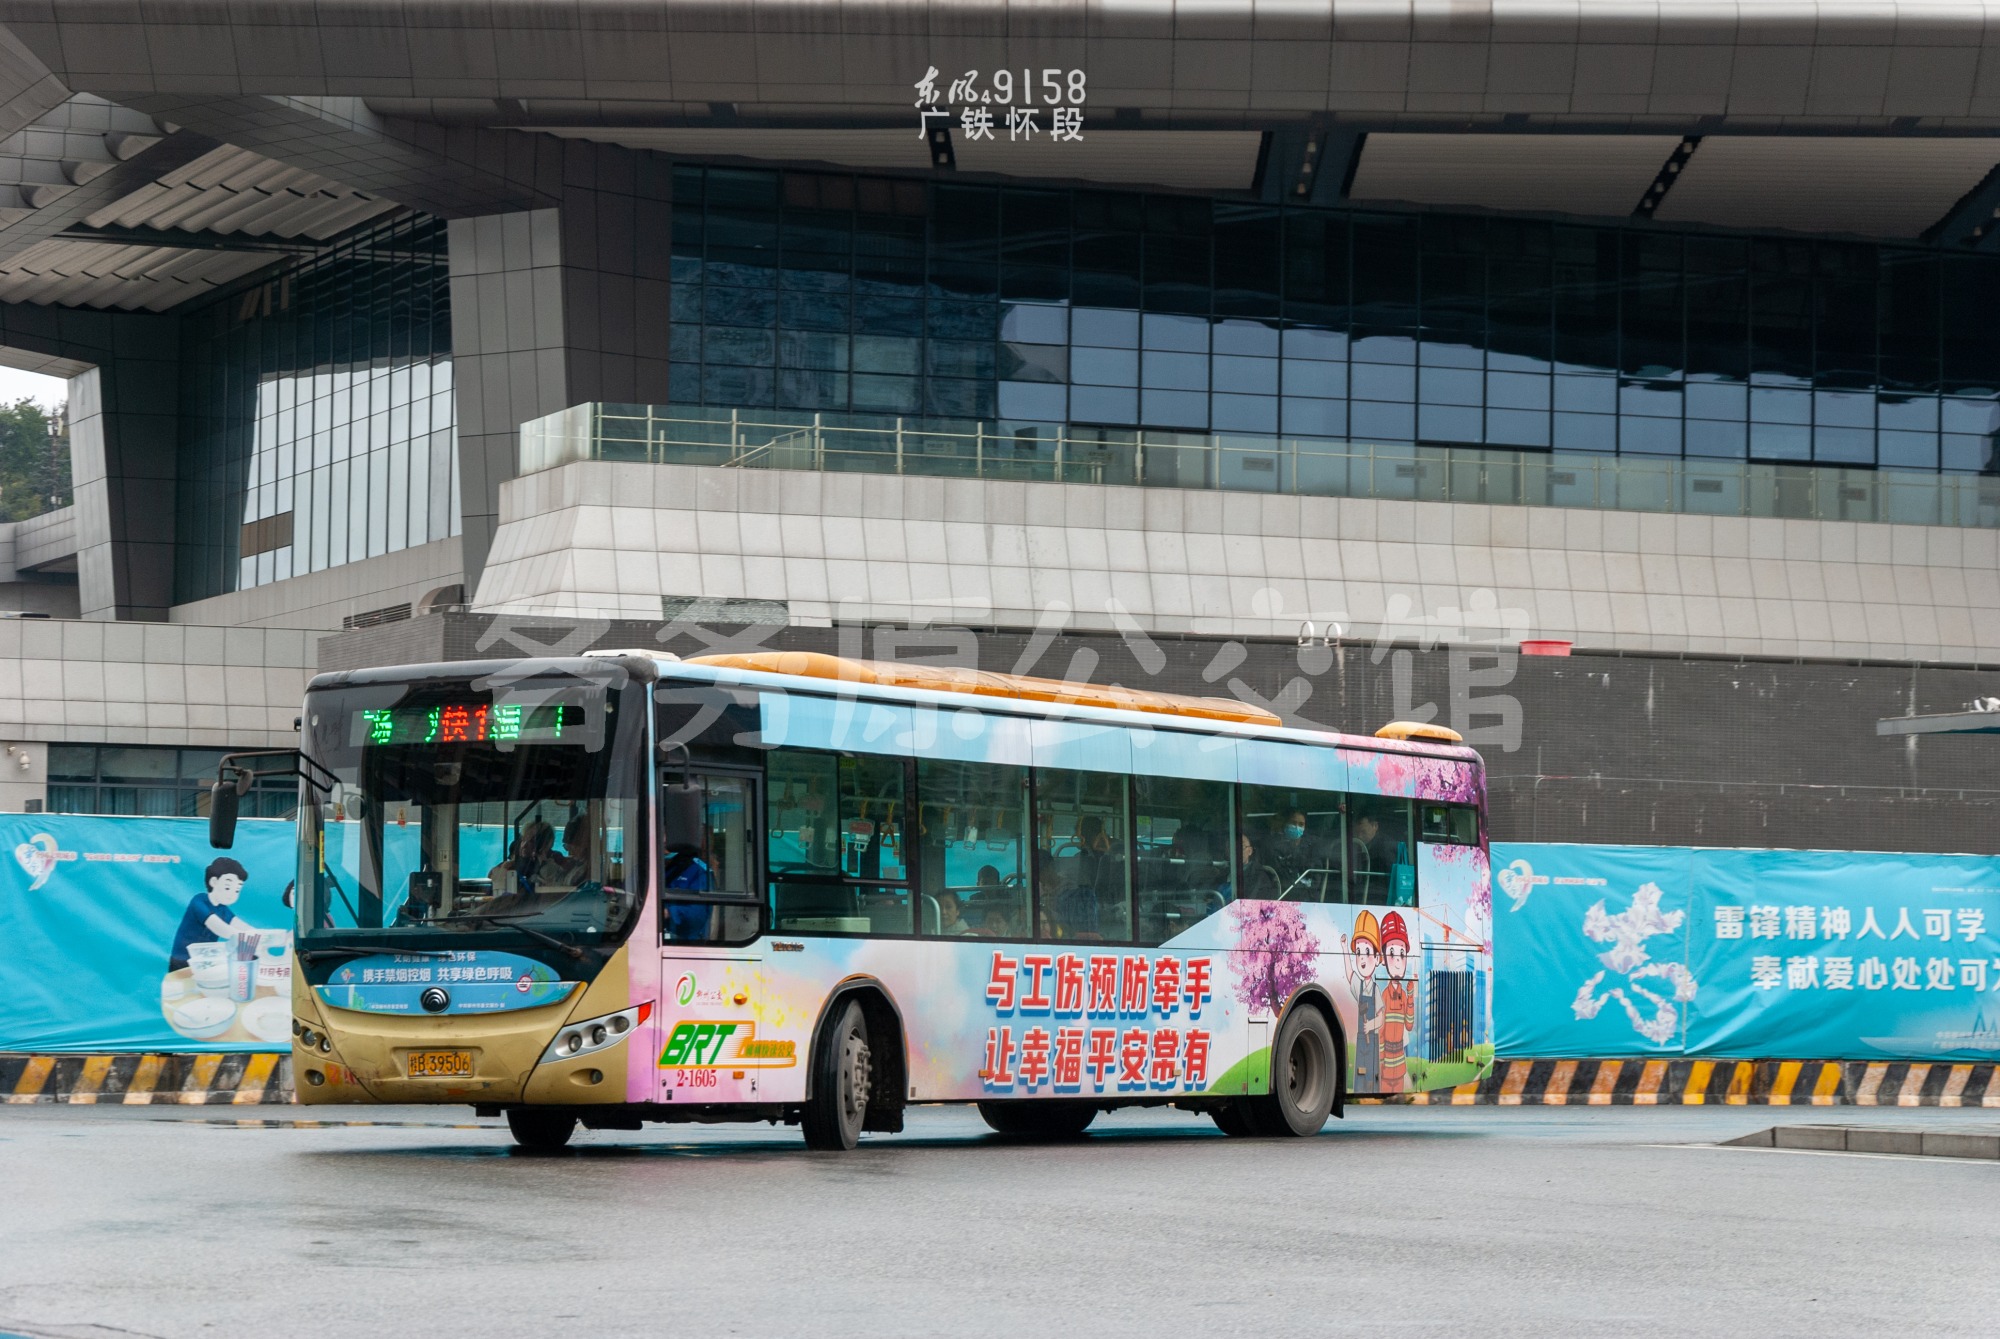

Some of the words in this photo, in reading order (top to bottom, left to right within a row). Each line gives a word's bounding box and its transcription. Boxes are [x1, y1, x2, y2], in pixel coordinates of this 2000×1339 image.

[1714, 905, 1986, 942] 雷锋精神人人可学
[363, 968, 431, 983] 携手禁烟控烟
[437, 967, 512, 982] 共享绿色呼吸
[986, 951, 1212, 1018] 与工伤预防牵手
[1751, 956, 2000, 992] 奉献爱心处处可
[660, 1024, 737, 1065] BRT
[985, 1025, 1211, 1092] 让幸福平安常有
